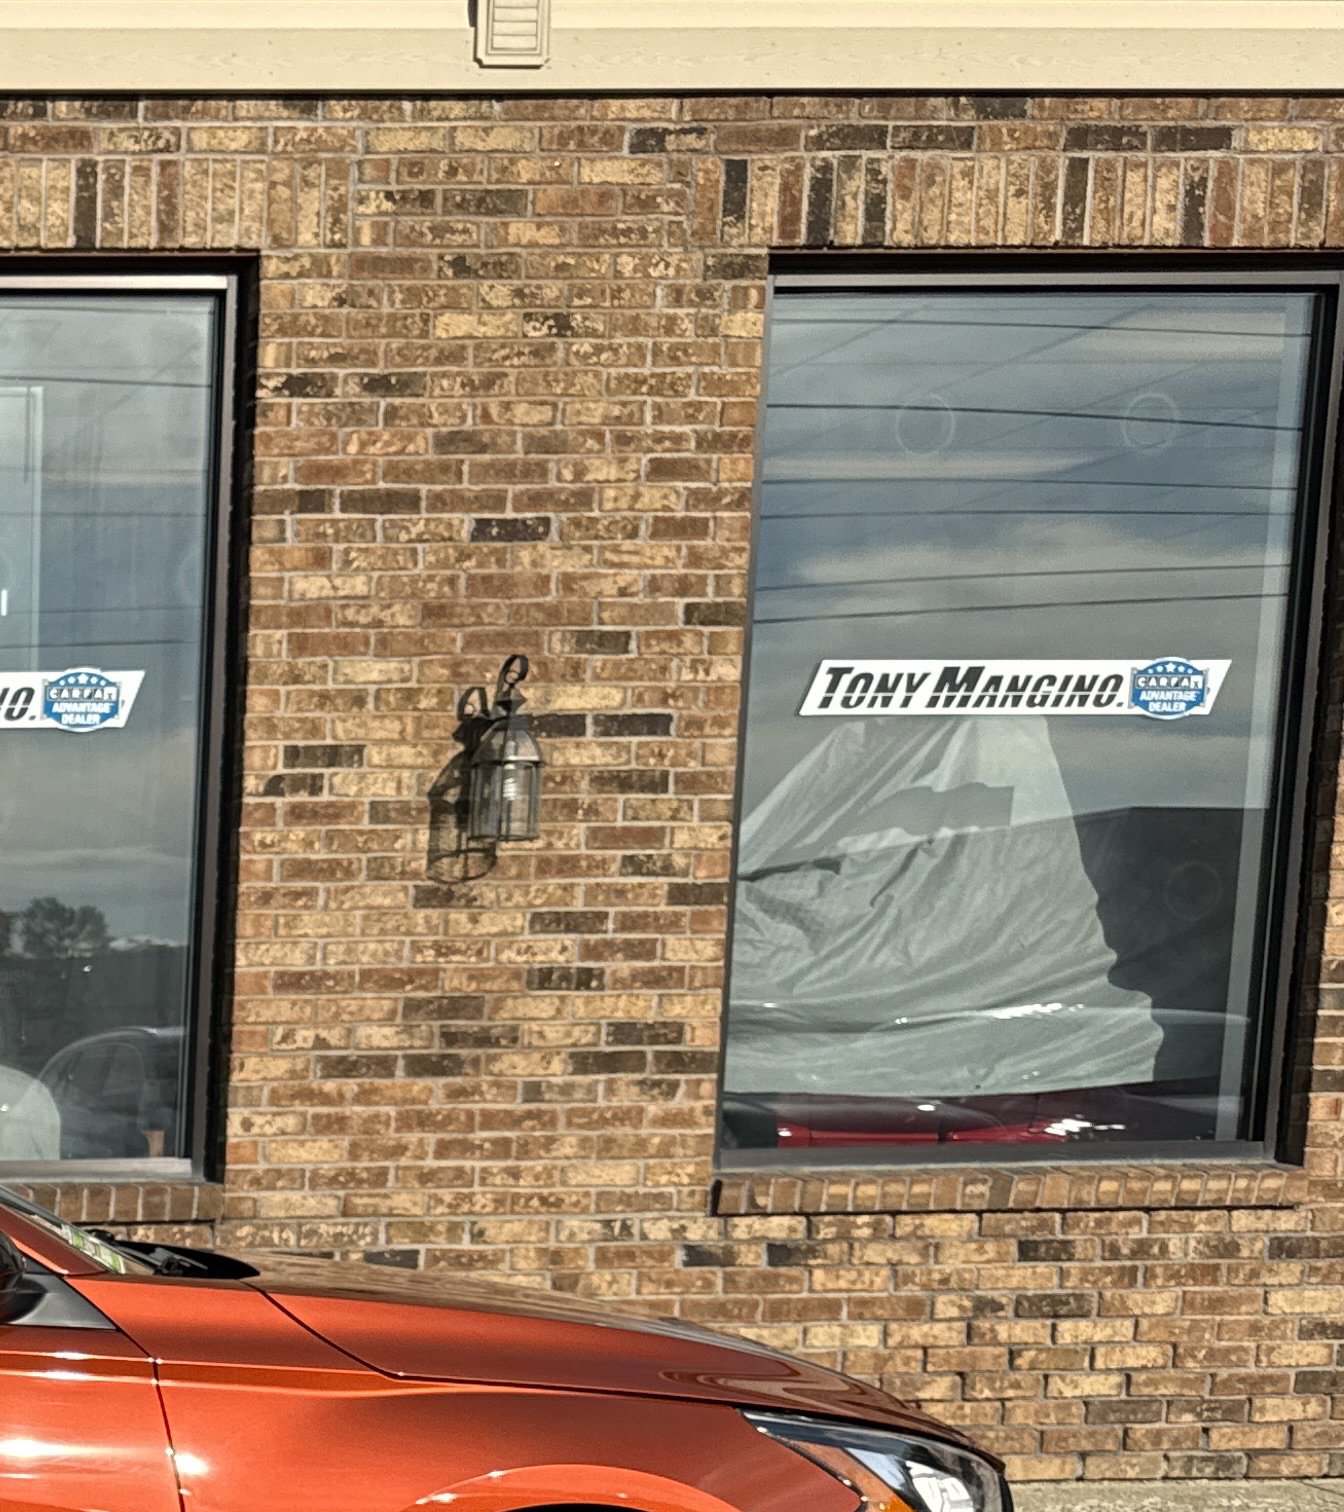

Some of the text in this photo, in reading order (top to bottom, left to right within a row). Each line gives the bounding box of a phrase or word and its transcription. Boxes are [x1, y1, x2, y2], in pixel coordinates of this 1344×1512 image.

[817, 666, 931, 709] TONY
[1137, 675, 1203, 688] CARFAX
[48, 687, 117, 701] CARFAX
[1139, 690, 1198, 702] ADVANTAGE
[52, 702, 111, 714] ADVANTAGE
[1148, 702, 1186, 713] DEALER
[61, 714, 101, 725] DEALER
